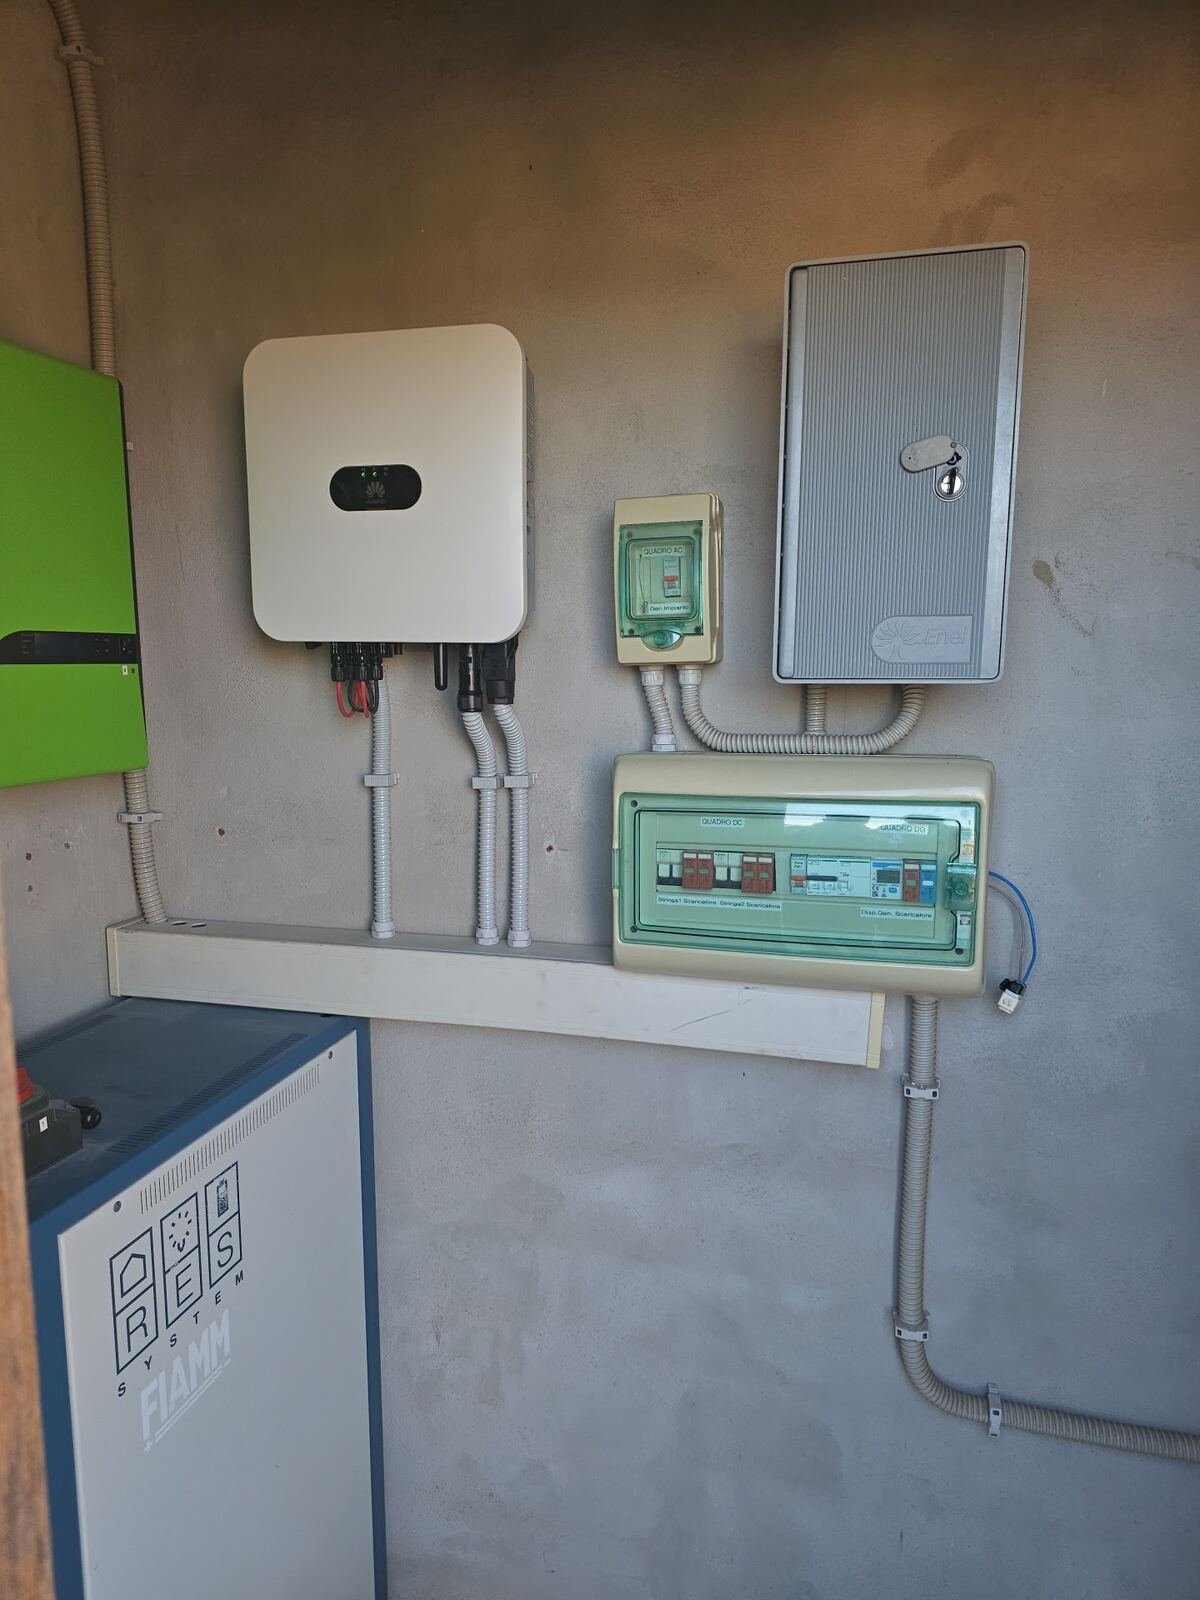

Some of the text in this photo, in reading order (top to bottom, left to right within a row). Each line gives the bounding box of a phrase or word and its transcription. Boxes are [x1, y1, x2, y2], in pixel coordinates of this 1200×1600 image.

[924, 626, 968, 645] Enel
[117, 1270, 244, 1398] SYSTEM
[140, 1308, 231, 1442] FIAMM
